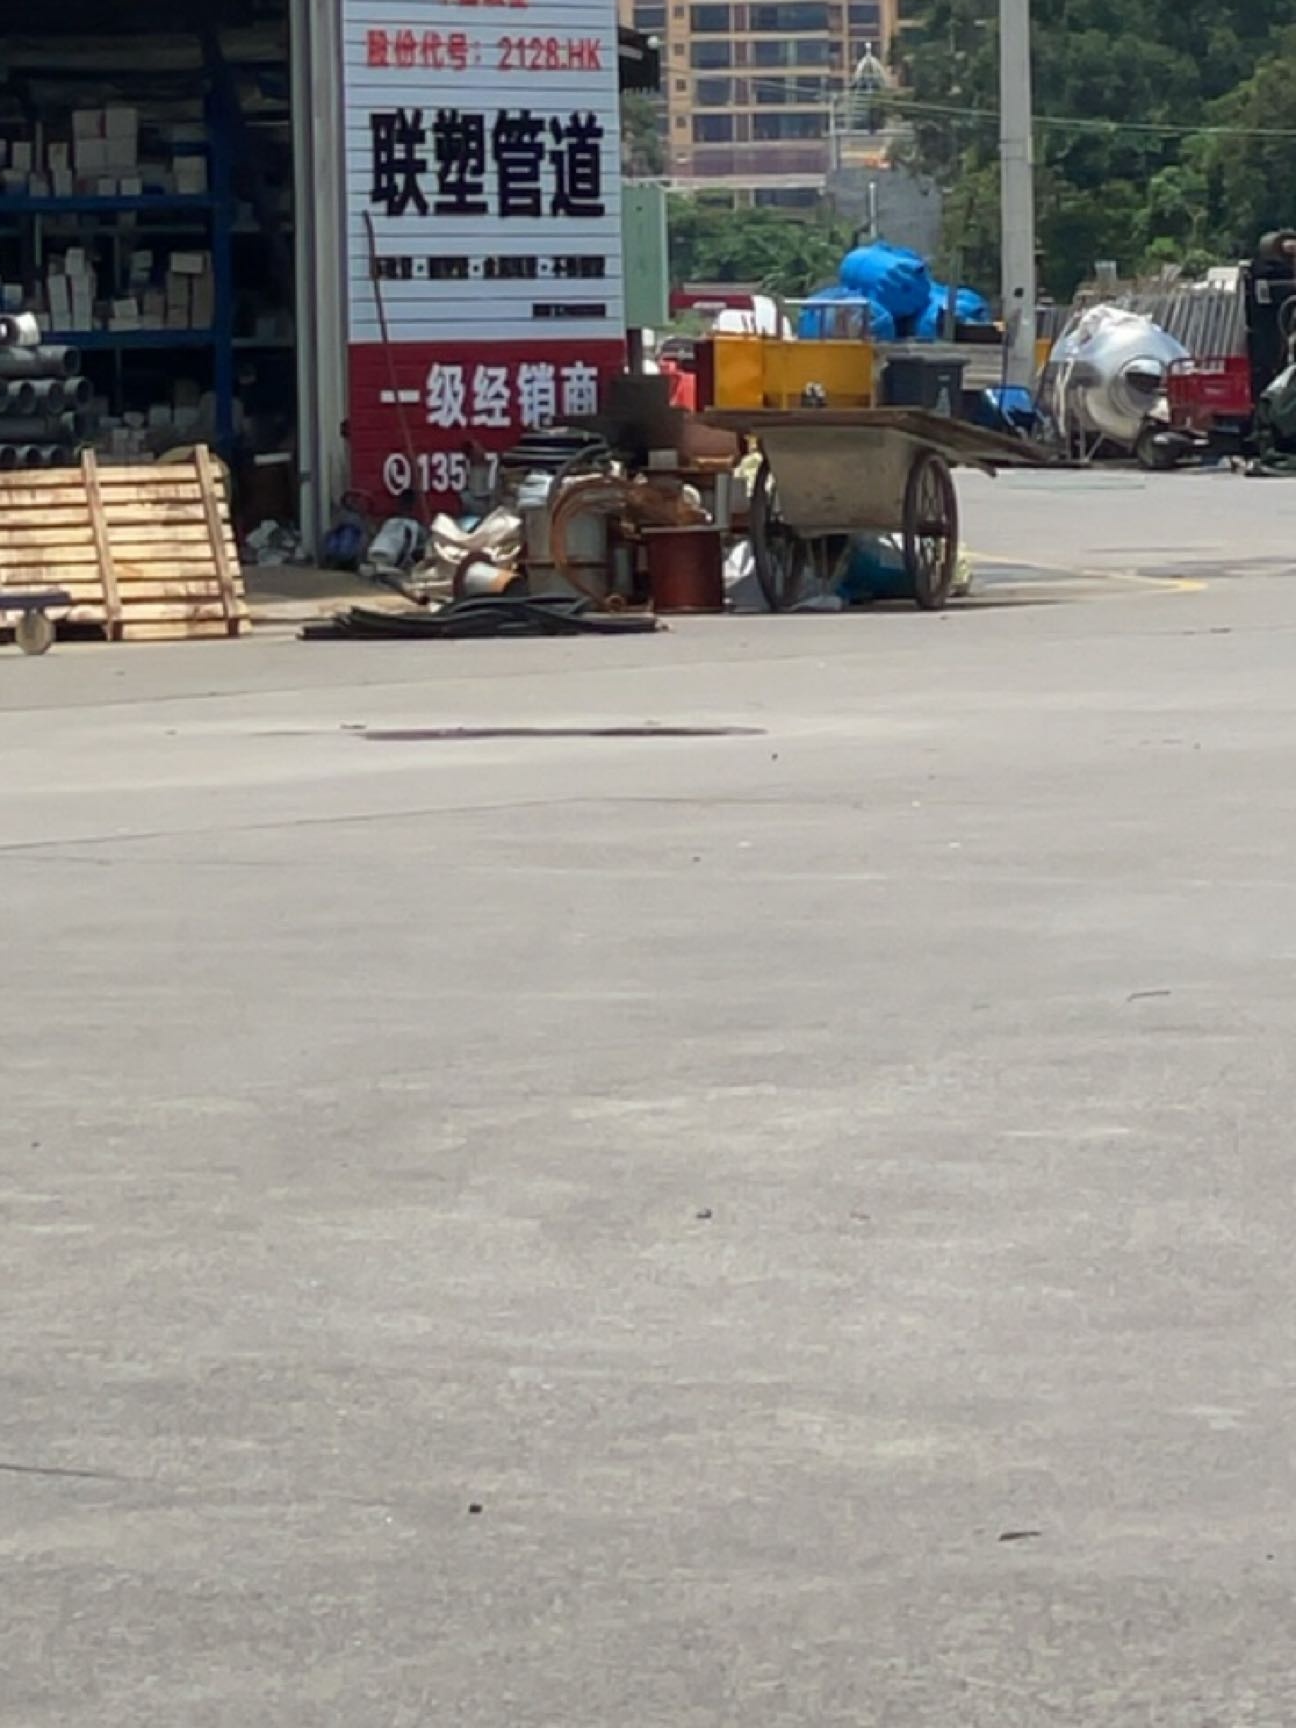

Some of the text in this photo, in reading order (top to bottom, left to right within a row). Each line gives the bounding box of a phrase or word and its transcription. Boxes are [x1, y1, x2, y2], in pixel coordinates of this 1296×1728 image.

[370, 109, 606, 217] 联塑管道
[380, 360, 598, 429] 一级经销商
